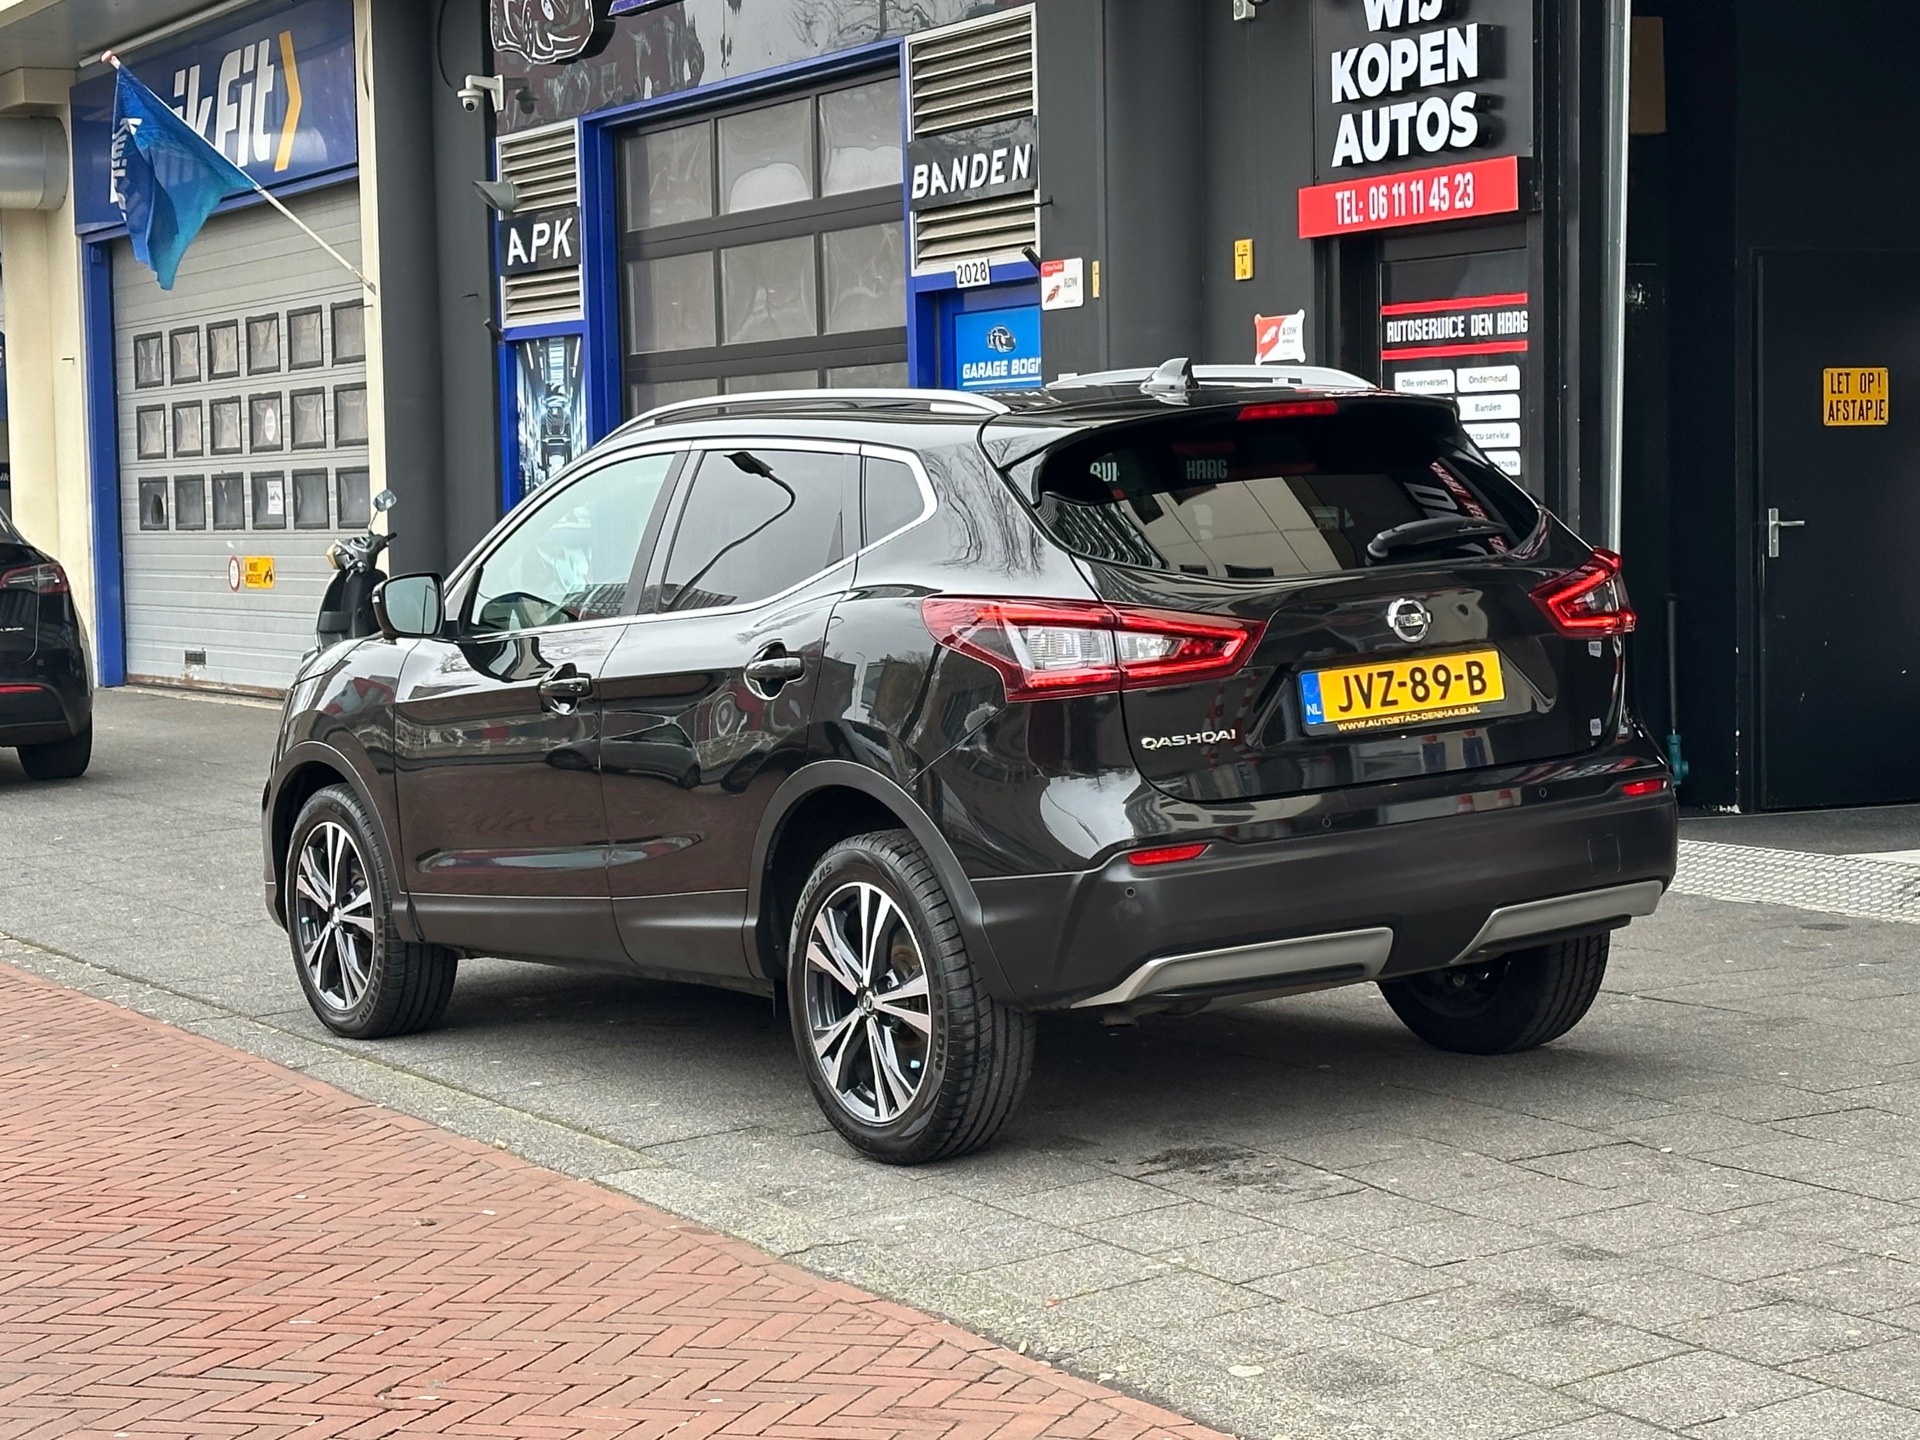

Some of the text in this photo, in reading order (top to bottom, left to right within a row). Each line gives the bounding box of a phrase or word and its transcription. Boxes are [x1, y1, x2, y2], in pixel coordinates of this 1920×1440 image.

[1331, 22, 1478, 104] KOPEN
[1331, 91, 1478, 167] AUTOS
[911, 144, 1033, 199] BANDEN
[1335, 171, 1474, 225] TEL: 06 11 11 45 23
[507, 217, 573, 266] APK
[957, 263, 988, 285] 2028
[1471, 313, 1493, 337] DEN
[1497, 310, 1528, 335] HAAG
[963, 358, 1041, 378] GARAGE BOGI
[1830, 372, 1881, 394] LET OP!
[1475, 404, 1501, 413] Banden
[1828, 399, 1886, 421] AFSTAPJE
[1186, 459, 1228, 480] HAAG
[1338, 661, 1487, 713] JVZ-89-B
[1306, 703, 1321, 716] NL
[1141, 729, 1236, 751] QASHQAI
